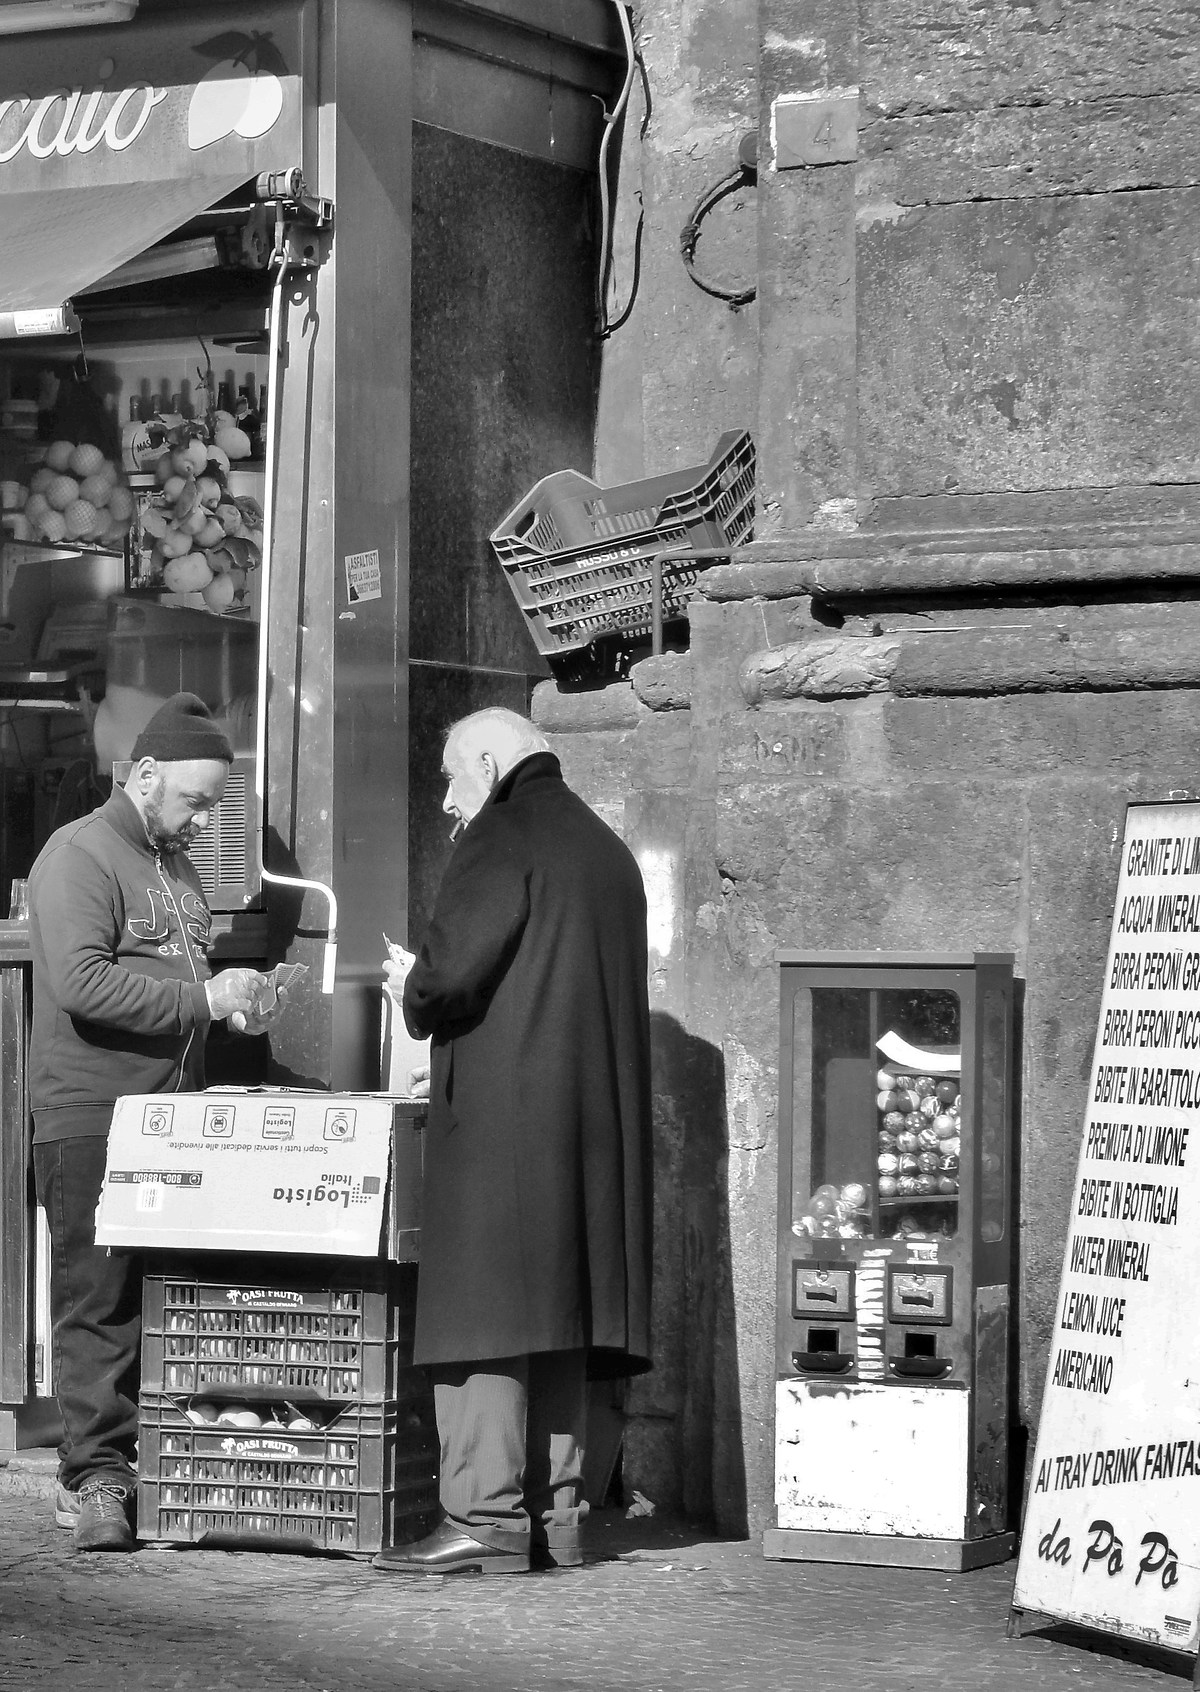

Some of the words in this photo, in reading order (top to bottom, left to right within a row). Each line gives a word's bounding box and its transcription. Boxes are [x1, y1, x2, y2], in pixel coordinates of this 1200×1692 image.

[813, 111, 836, 152] 4
[1127, 837, 1172, 876] GRANITE
[1171, 837, 1185, 876] DI
[1118, 895, 1154, 935] ACQUA
[1154, 895, 1200, 932] MINERAL
[1110, 952, 1141, 989] BIRRA
[1141, 952, 1182, 990] PERONI
[1102, 1009, 1133, 1046] BIRRA
[1133, 1009, 1174, 1048] PERONI
[1173, 1010, 1200, 1049] PICC
[1094, 1066, 1128, 1103] BIBITE
[1126, 1067, 1140, 1104] IN
[266, 1119, 291, 1127] Logista
[205, 1141, 219, 1151] alle
[220, 1141, 252, 1152] dedicati
[253, 1142, 278, 1152] servizi
[285, 1143, 302, 1153] tutti
[303, 1144, 328, 1155] Scopri
[1086, 1122, 1133, 1162] PREMUTA
[1133, 1125, 1147, 1163] DI
[1145, 1126, 1189, 1167] LIMONE
[273, 1184, 350, 1208] Logista
[321, 1174, 352, 1186] Italia
[1078, 1178, 1111, 1218] BIBITE
[1110, 1181, 1123, 1219] IN
[1122, 1182, 1178, 1225] BOTTIGLIA
[1070, 1235, 1105, 1275] WATER
[1104, 1238, 1150, 1281] MINERAL
[242, 1290, 266, 1302] OASI
[267, 1290, 303, 1305] FRUTTA
[1061, 1291, 1098, 1333] LEMON
[1096, 1296, 1126, 1337] JUCE
[1052, 1348, 1113, 1395] AMERICANO
[236, 1440, 260, 1452] OASI
[262, 1440, 299, 1457] FRUTTA
[1054, 1452, 1092, 1491] TRAY
[1092, 1446, 1142, 1486] DRINK
[1038, 1517, 1072, 1567] da
